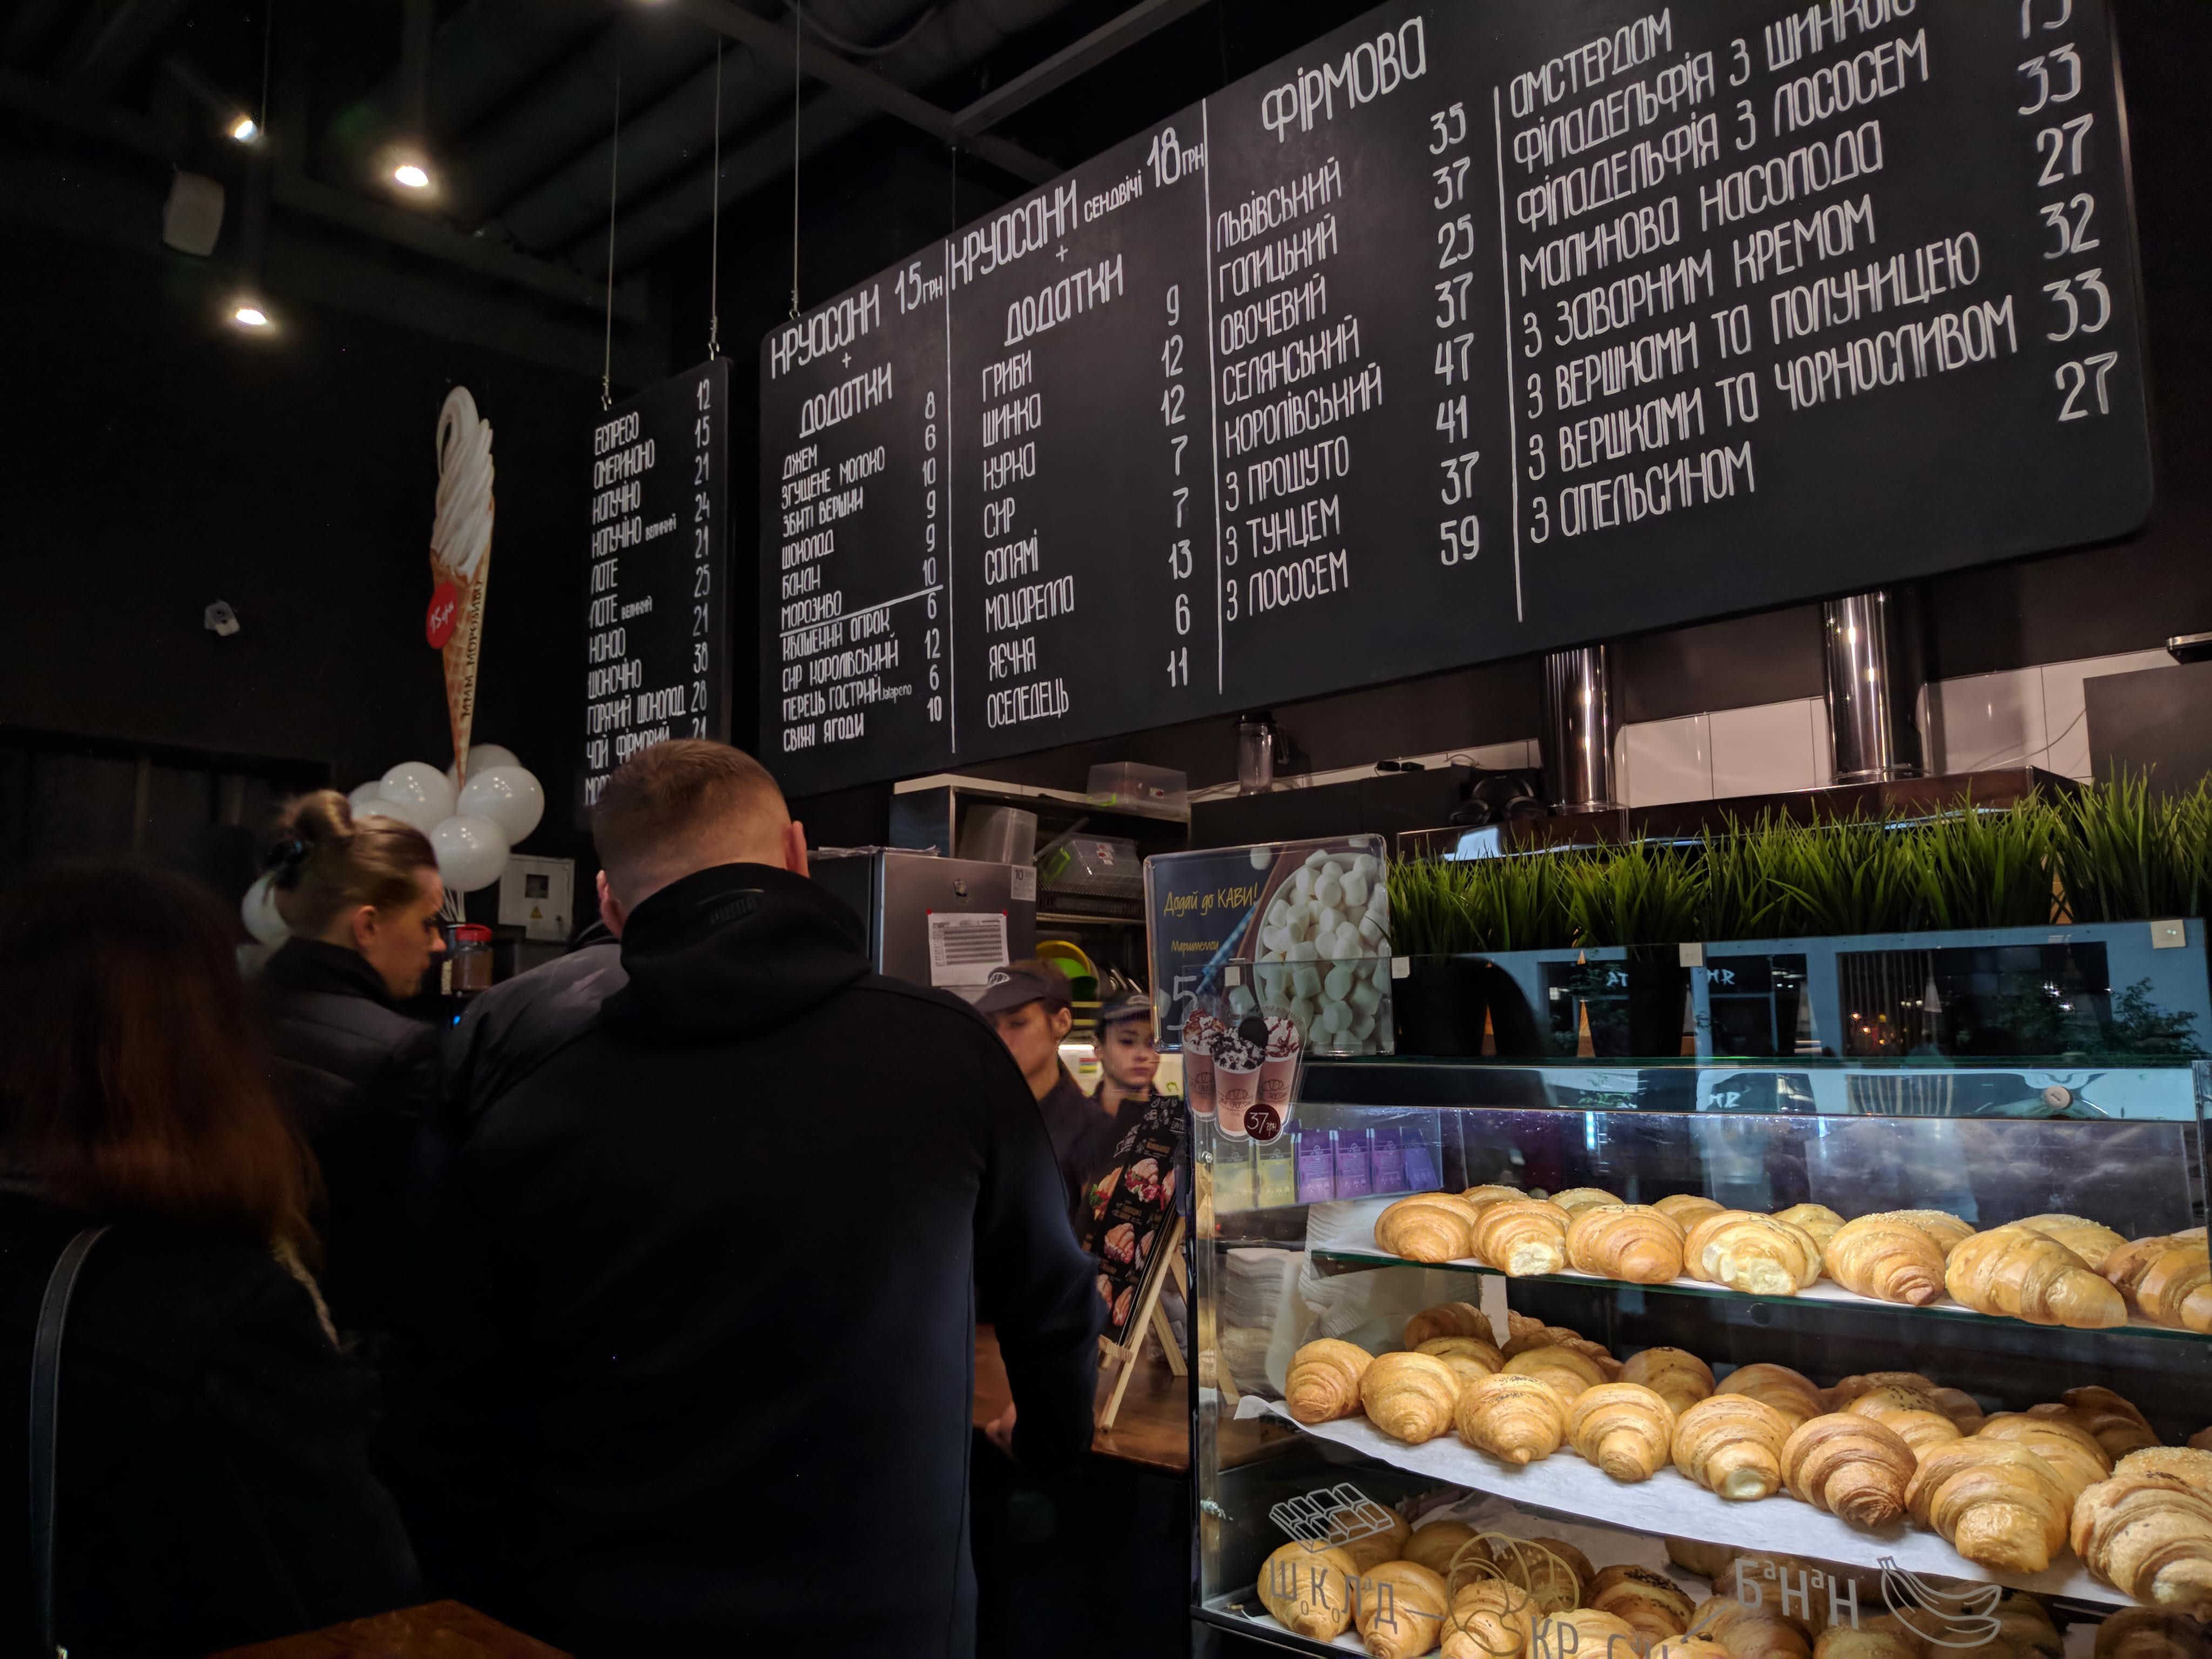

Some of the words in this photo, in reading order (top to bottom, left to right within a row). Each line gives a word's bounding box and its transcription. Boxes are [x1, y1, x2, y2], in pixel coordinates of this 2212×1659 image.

[1262, 16, 1427, 143] ФІРМОВА
[1510, 8, 1672, 118] АМСТЕРДАМ
[2018, 43, 2081, 116] 33
[1429, 102, 1467, 155] 35
[1513, 51, 1715, 174] ФІЛАДЕЛЬФІЯ
[1517, 112, 1719, 233] ФІЛАДЕЛЬФІЯ
[1774, 28, 1928, 137] ЛОСОСЕМ
[2036, 113, 2094, 187] 27
[1217, 156, 1342, 253] ЛЬВІВСЬКИЙ
[1432, 156, 1471, 210] 37
[1520, 195, 1680, 297] МАЛИНОВА
[1700, 120, 1883, 232] НАСОЛОДА
[2040, 192, 2101, 260] 32
[951, 179, 1077, 291] КРУАСАНИ
[1219, 213, 1338, 303] ГАЛИЦЬКИЙ
[1438, 213, 1474, 269] 25
[1555, 249, 1714, 346] ЗАВАРНИМ
[1733, 193, 1876, 288] КРЕМОМ
[1004, 254, 1123, 346] ДОДАТКИ
[1166, 284, 1179, 326] 9
[1220, 273, 1326, 355] ОВОЧЕВИЙ
[1435, 272, 1474, 327] 37
[1556, 321, 1700, 410] ВЕРШКАМИ
[1711, 304, 1752, 359] ТА
[1771, 231, 1980, 345] ПОЛУНИЦЕЮ
[2043, 267, 2112, 342] 33
[772, 284, 880, 379] КРУАСАНИ
[1161, 335, 1183, 377] 12
[982, 349, 1031, 402] ГРИБИ
[1223, 315, 1359, 406] СЕЛЯНСЬКИЙ
[1434, 332, 1475, 386] 47
[1559, 387, 1705, 473] ВЕРШКАМИ
[1715, 372, 1759, 427] ТА
[1774, 294, 2018, 411] ЧОРНОСЛИВОМ
[696, 379, 711, 411] 12
[799, 362, 892, 438] ДОДАТКИ
[925, 391, 936, 420] 8
[1161, 385, 1185, 426] 12
[1225, 362, 1383, 458] КОРОЛІВСЬКИЙ
[2055, 351, 2118, 422] 27
[595, 412, 639, 456] ЕСПРЕСО
[694, 416, 710, 448] 15
[925, 424, 936, 451] 6
[983, 393, 1041, 447] ШИНКА
[1434, 395, 1468, 443] 41
[594, 439, 655, 489] АМЕРИКАНО
[694, 452, 709, 485] 21
[782, 444, 818, 480] ДЖЕМ
[839, 446, 885, 486] МОЛОКО
[922, 457, 936, 487] 10
[983, 441, 1035, 491] КУРКА
[1171, 435, 1188, 476] 7
[1248, 435, 1350, 505] ПРОШУТО
[1440, 451, 1480, 505] 37
[694, 492, 710, 522] 24
[783, 505, 813, 538] ЗБИТІ
[819, 486, 863, 525] ВЕРШКИ
[926, 490, 936, 518] 9
[1173, 487, 1189, 528] 7
[1560, 440, 1755, 537] АПЕЛЬСИНОМ
[695, 525, 709, 558] 21
[926, 523, 936, 552] 9
[984, 497, 1015, 538] СИР
[1246, 494, 1340, 558] ТУНЦЕМ
[1440, 514, 1480, 566] 59
[781, 529, 834, 569] ШОКОЛАД
[922, 557, 936, 586] 10
[985, 529, 1038, 585] САЛЯМІ
[1168, 539, 1192, 579] 13
[590, 558, 619, 595] ЛАТЕ
[694, 564, 711, 598] 25
[782, 564, 820, 600] БАНАН
[1249, 548, 1348, 617] ЛОСОСЕМ
[589, 594, 618, 629] ЛАТЕ
[693, 603, 709, 637] 21
[781, 590, 842, 630] МОРОЗИВО
[850, 608, 891, 642] ОГІРОК
[927, 592, 937, 619] 6
[986, 575, 1074, 633] МОЦАРЕЛЛА
[1175, 594, 1190, 635] 6
[589, 627, 626, 664] КАКАО
[783, 665, 802, 692] СИР
[810, 631, 899, 686] КОРОЛІВСЬКИЙ
[924, 628, 940, 659] 12
[989, 637, 1036, 682] ЯЄЧНЯ
[1167, 646, 1188, 687] 11
[784, 690, 826, 722] ПЕРЕЦЬ
[829, 673, 881, 711] ГОСТРИЙ
[929, 664, 939, 690] 6
[637, 685, 686, 724] ШОКОЛАД
[927, 695, 942, 722] 10
[987, 678, 1069, 729] ОСЕЛЕДЕЦЬ
[587, 734, 609, 770] ЧАЙ
[784, 723, 815, 752] СВІЖІ
[824, 712, 864, 744] ЯГОДИ
